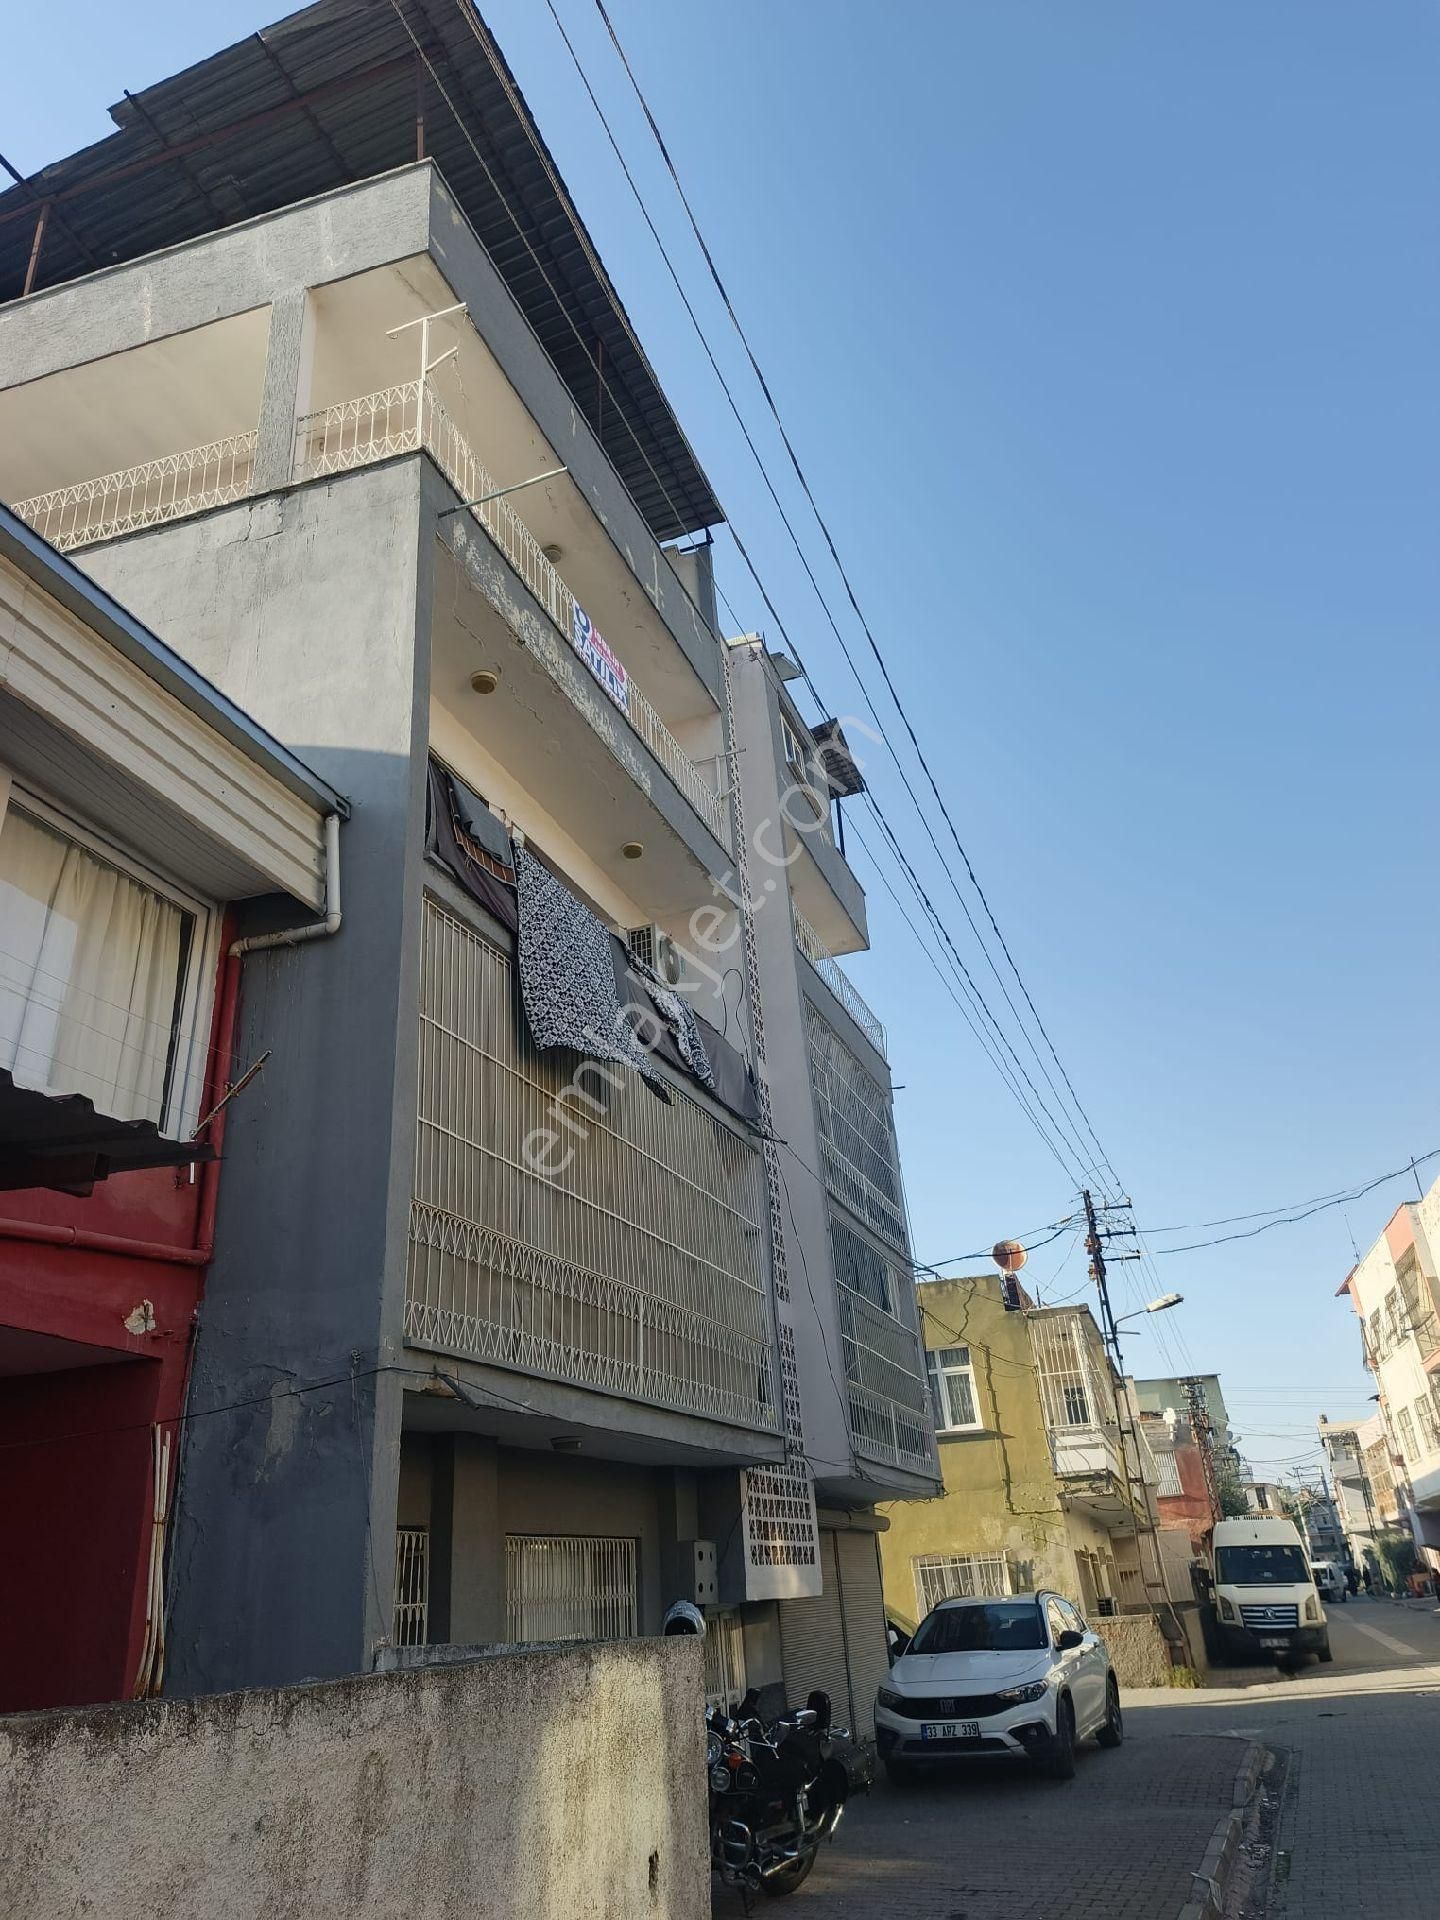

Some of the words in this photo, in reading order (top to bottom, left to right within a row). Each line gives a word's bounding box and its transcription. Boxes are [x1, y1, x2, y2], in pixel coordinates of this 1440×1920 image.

[574, 622, 628, 707] SATILIK
[927, 1726, 937, 1738] 33
[961, 1723, 977, 1736] 339
